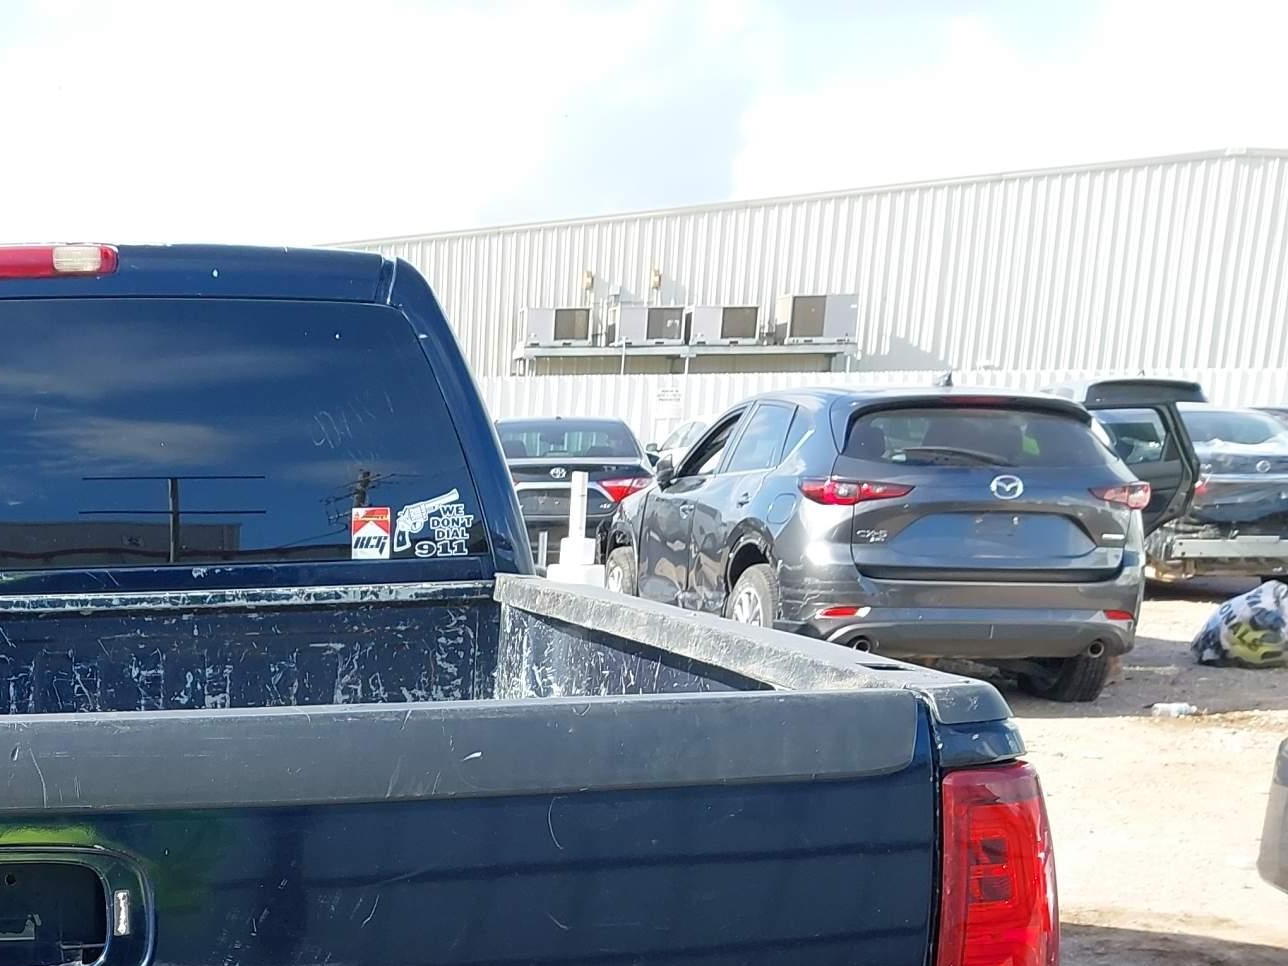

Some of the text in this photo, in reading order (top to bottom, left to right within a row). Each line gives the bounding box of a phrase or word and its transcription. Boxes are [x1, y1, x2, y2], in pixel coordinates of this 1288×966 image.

[441, 506, 464, 516] WE
[431, 516, 473, 528] DON'T
[436, 529, 469, 539] DIAL
[416, 541, 468, 556] 911
